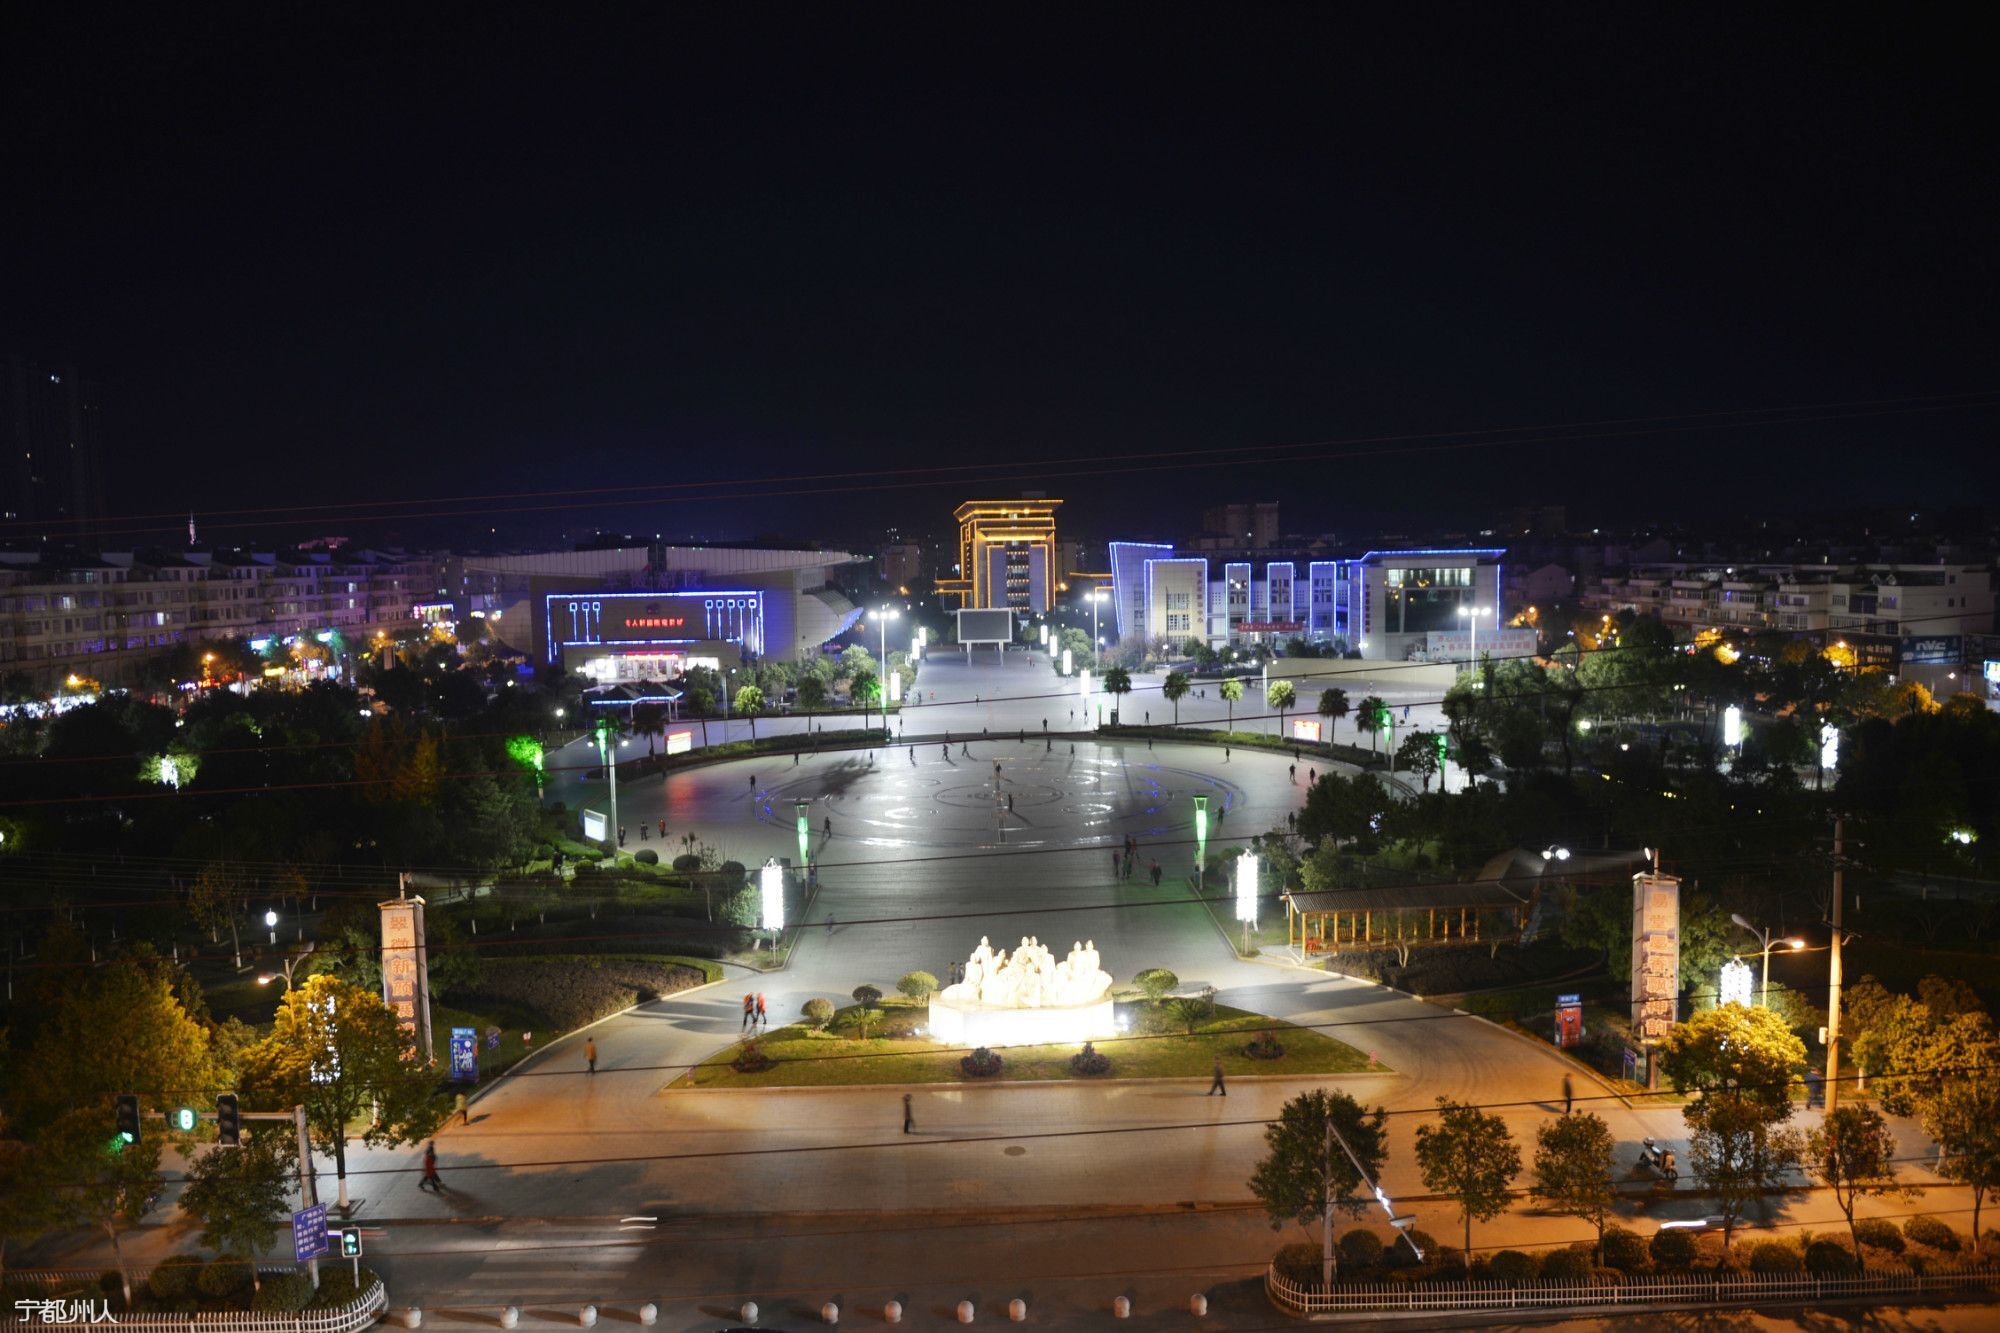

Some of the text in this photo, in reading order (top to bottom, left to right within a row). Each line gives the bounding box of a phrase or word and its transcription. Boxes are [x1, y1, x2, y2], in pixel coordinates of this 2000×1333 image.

[390, 916, 416, 1062] 翠微新颜展
